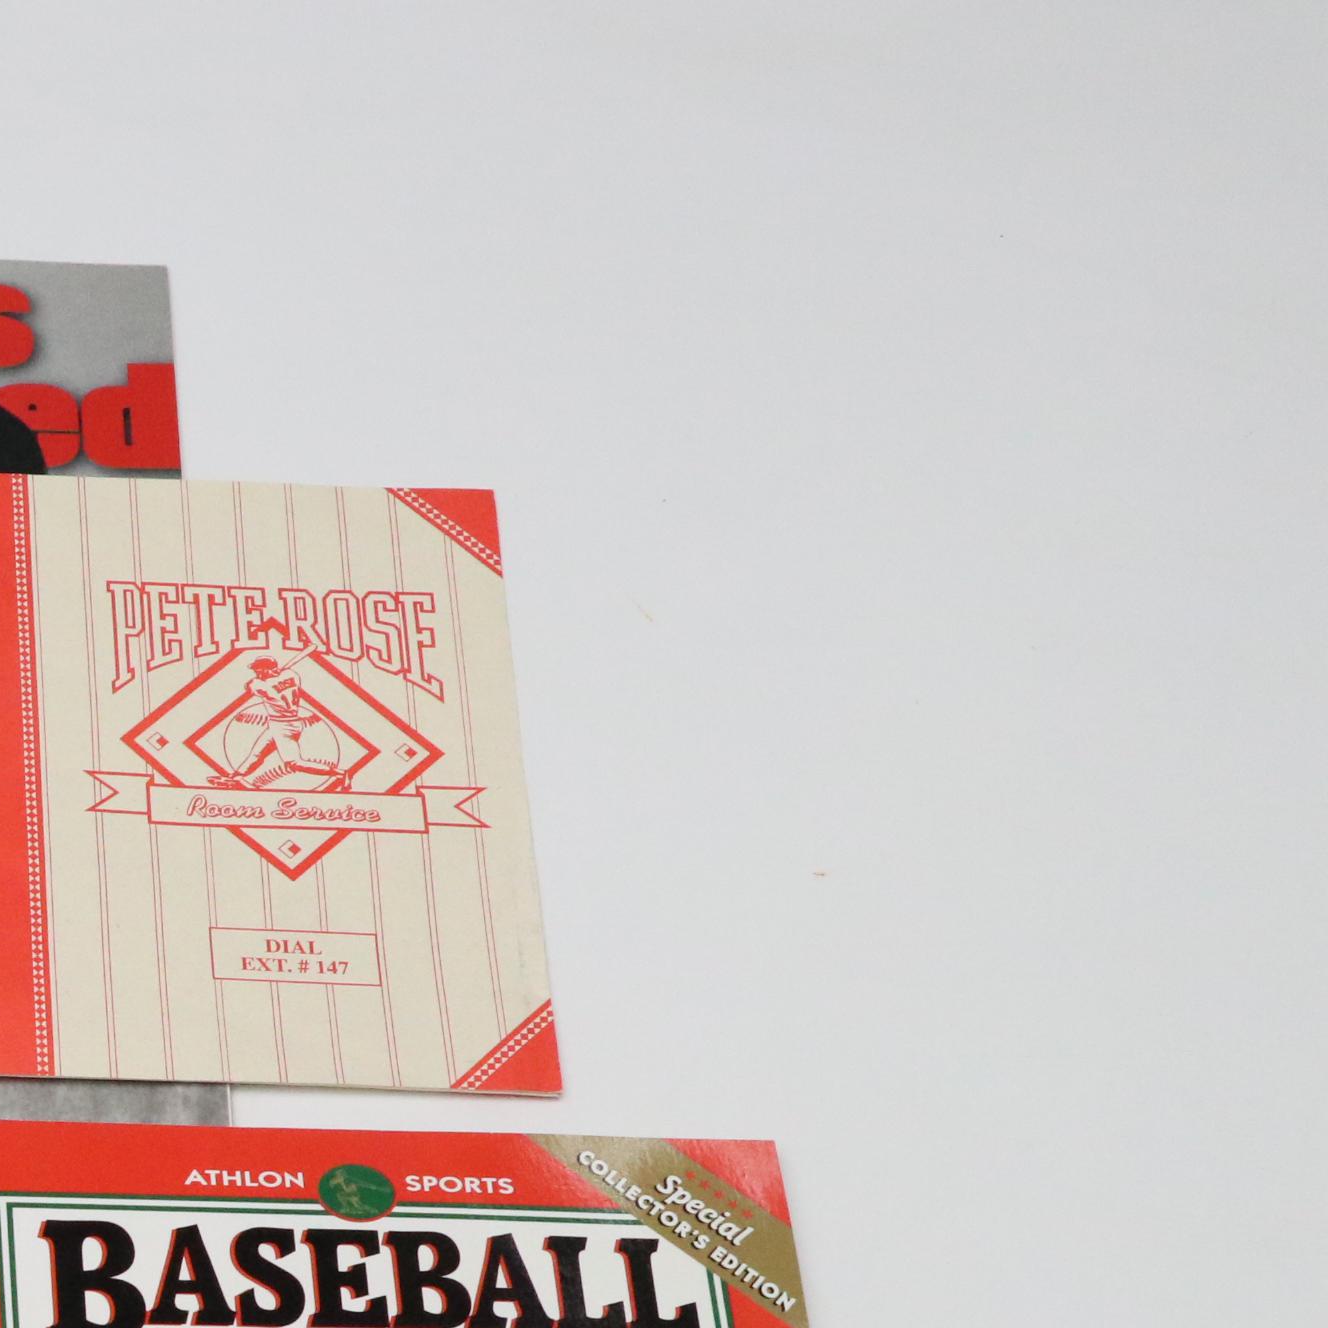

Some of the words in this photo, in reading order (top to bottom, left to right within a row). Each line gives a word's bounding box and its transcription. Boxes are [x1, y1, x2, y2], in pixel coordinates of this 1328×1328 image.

[106, 580, 272, 694] PETE
[278, 587, 444, 703] ROSE
[186, 794, 265, 820] Room
[272, 798, 381, 823] Service
[266, 939, 321, 955] DIAL
[242, 957, 292, 972] EXT.
[298, 960, 309, 973] #
[318, 961, 348, 974] 147
[184, 1168, 304, 1190] ATHLON
[404, 1173, 514, 1196] SPORTS
[656, 1175, 754, 1246] Special
[578, 1150, 710, 1250] COLLECTOR'S
[710, 1246, 796, 1312] EDITION
